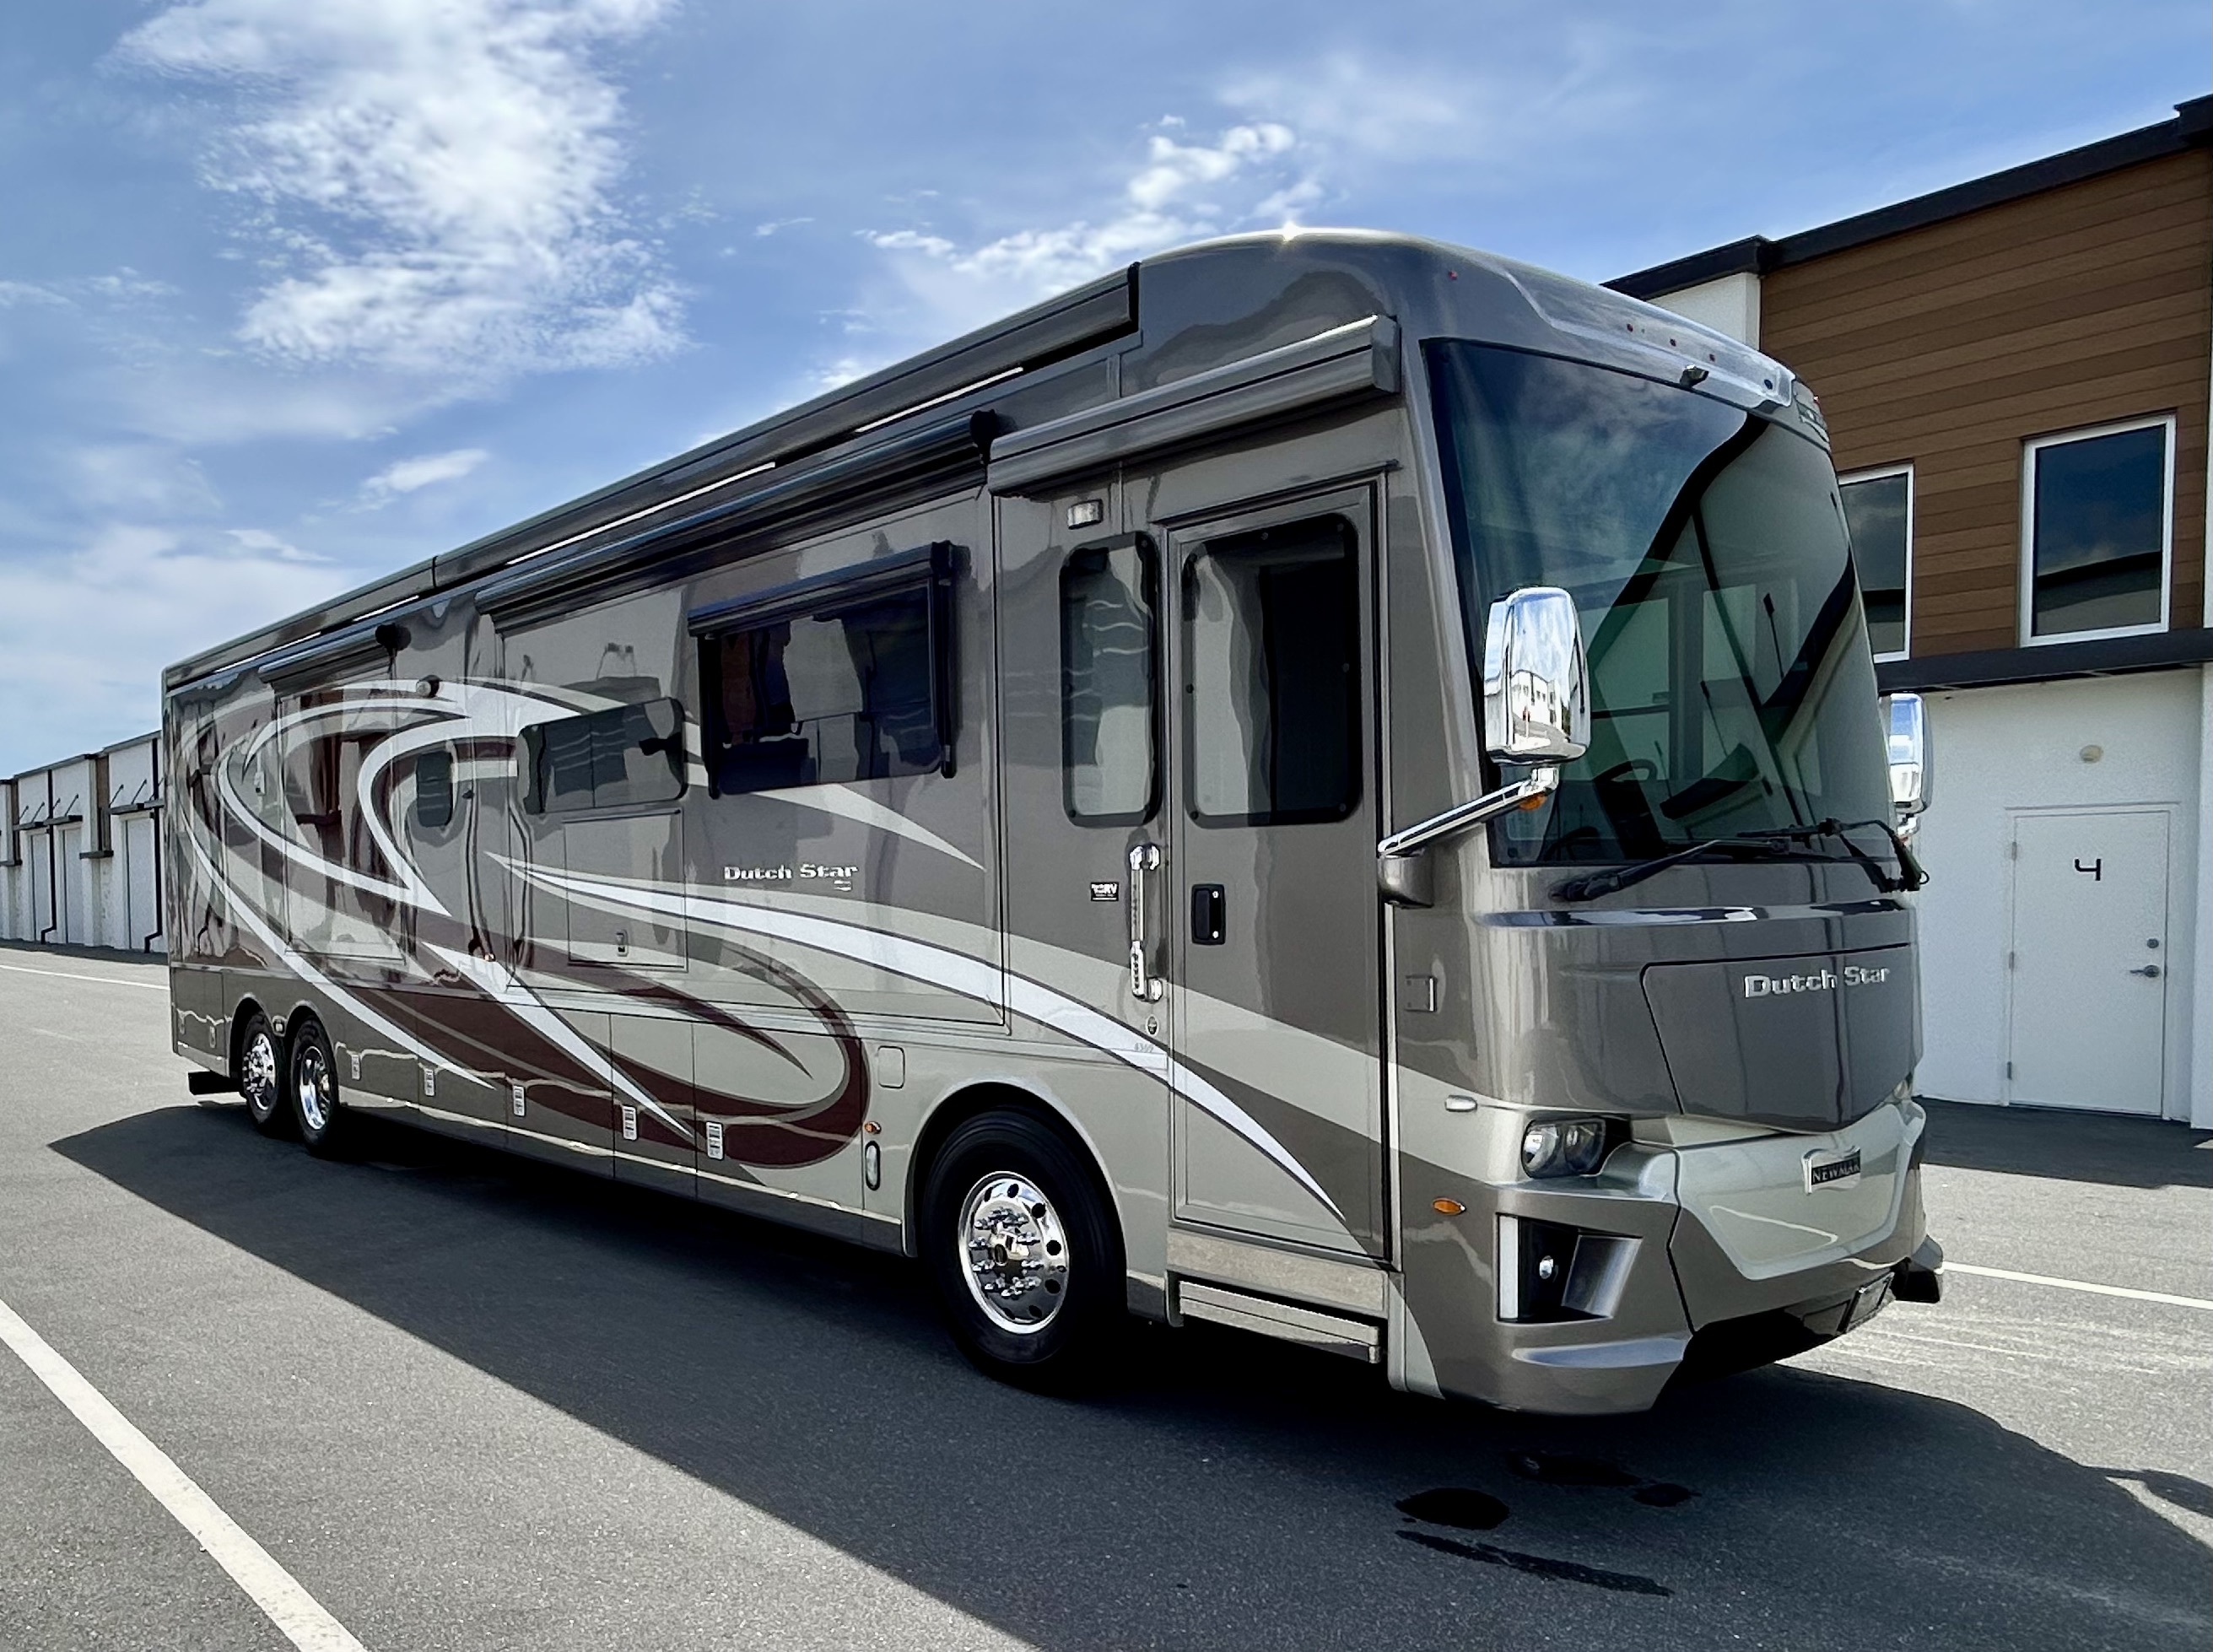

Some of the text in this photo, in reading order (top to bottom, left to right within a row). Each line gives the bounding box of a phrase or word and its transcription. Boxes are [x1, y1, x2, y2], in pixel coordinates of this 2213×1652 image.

[724, 863, 858, 880] Dutch Star
[2074, 858, 2102, 882] 4
[1744, 965, 1891, 998] Dutch Star
